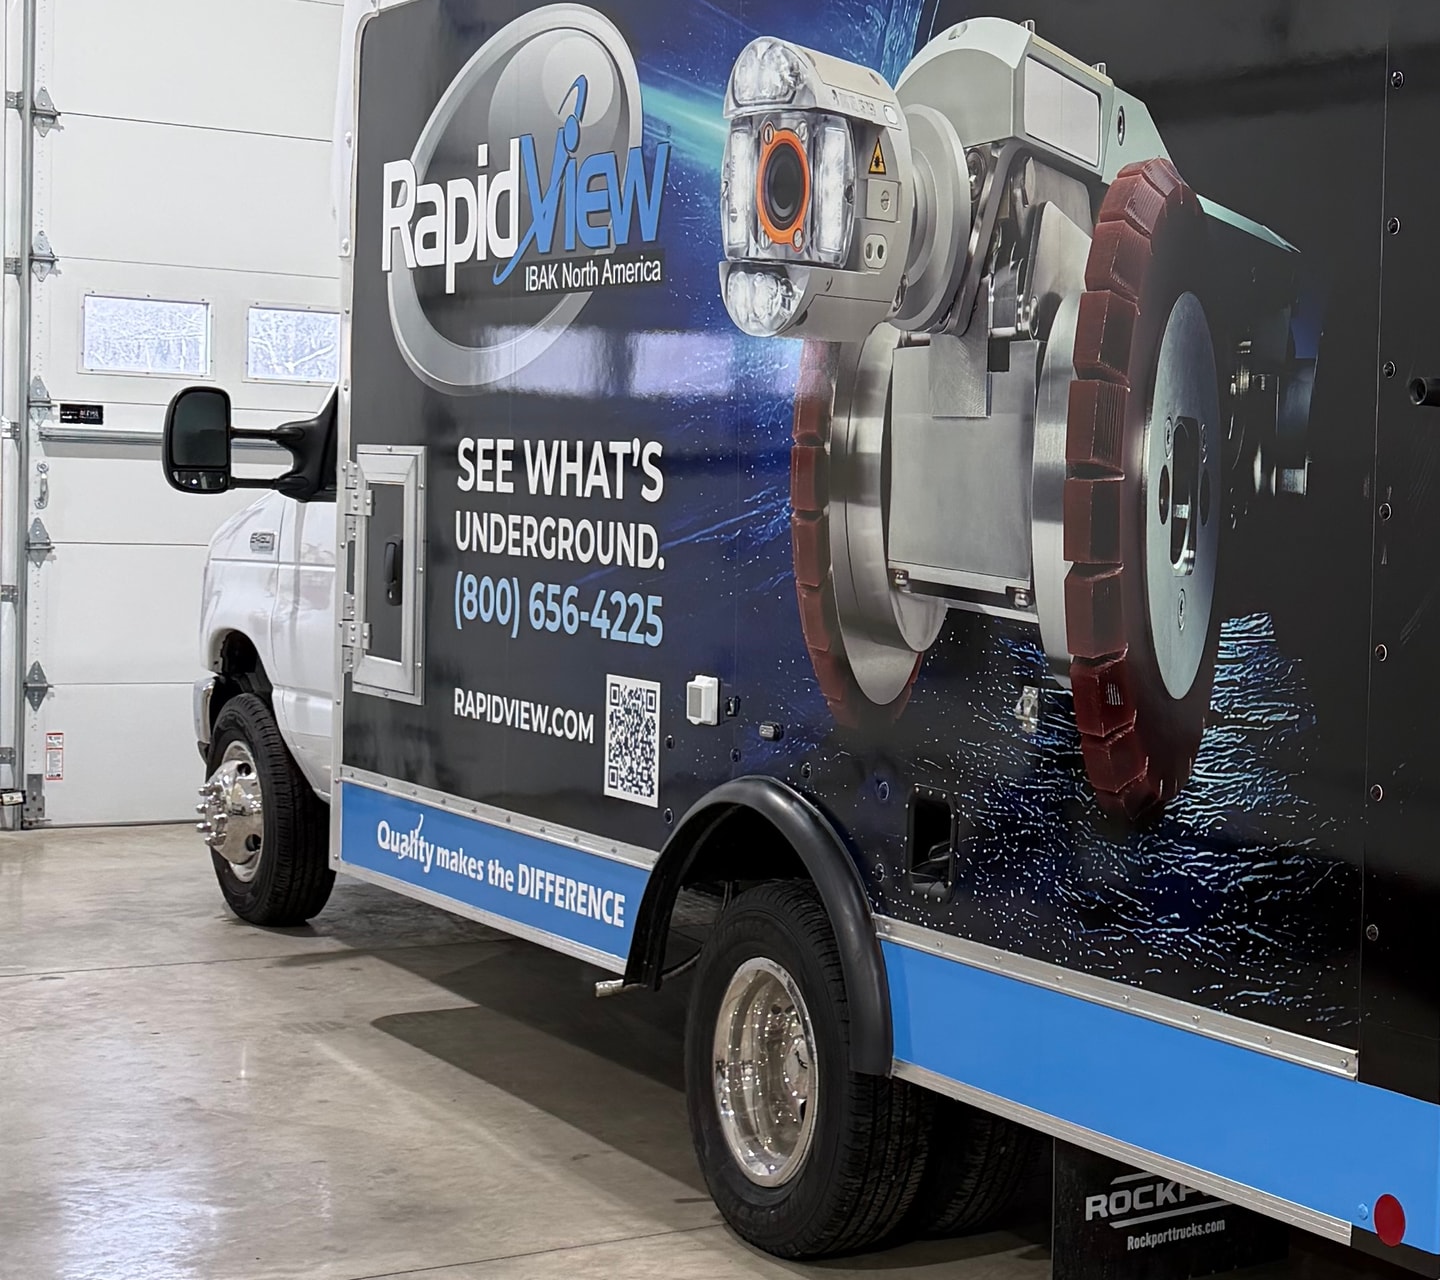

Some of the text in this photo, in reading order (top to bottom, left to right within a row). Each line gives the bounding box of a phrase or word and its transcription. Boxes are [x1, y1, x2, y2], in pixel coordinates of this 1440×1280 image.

[525, 259, 662, 292] IBAK North America
[456, 437, 664, 503] SEE WHAT'S
[455, 511, 666, 571] UNDERGROUND.
[454, 571, 664, 647] (800) 656-4225
[453, 687, 595, 745] RAPIDVIEW.COM
[377, 815, 626, 929] Quality makes the DIFFERENCE
[1127, 1218, 1226, 1251] Rockporttrucks.com
